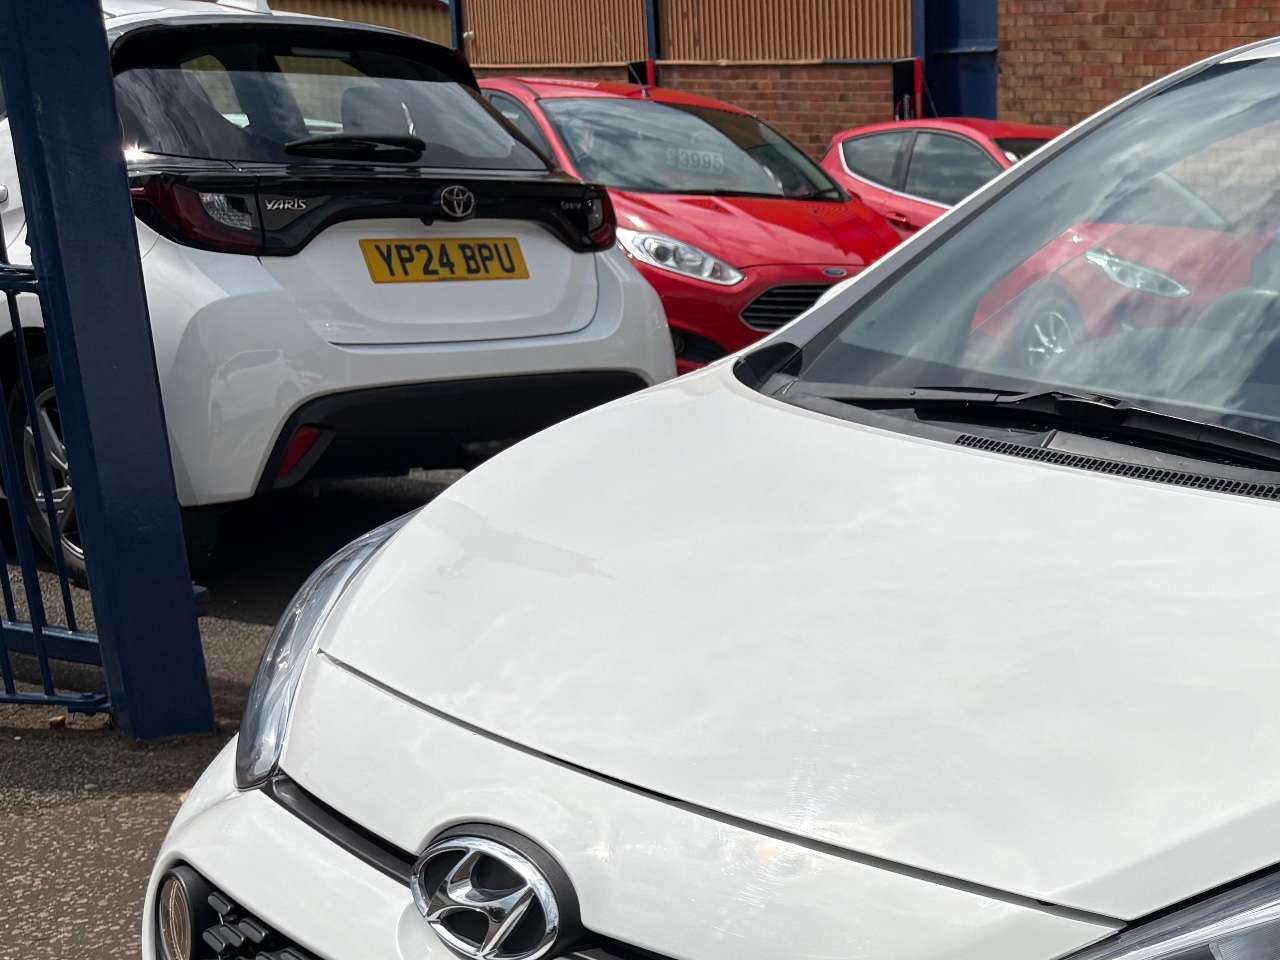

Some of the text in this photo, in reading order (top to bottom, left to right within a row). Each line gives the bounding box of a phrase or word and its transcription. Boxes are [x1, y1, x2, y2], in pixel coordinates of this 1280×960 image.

[264, 198, 307, 210] YARIS
[374, 243, 516, 277] YP24 BPU
